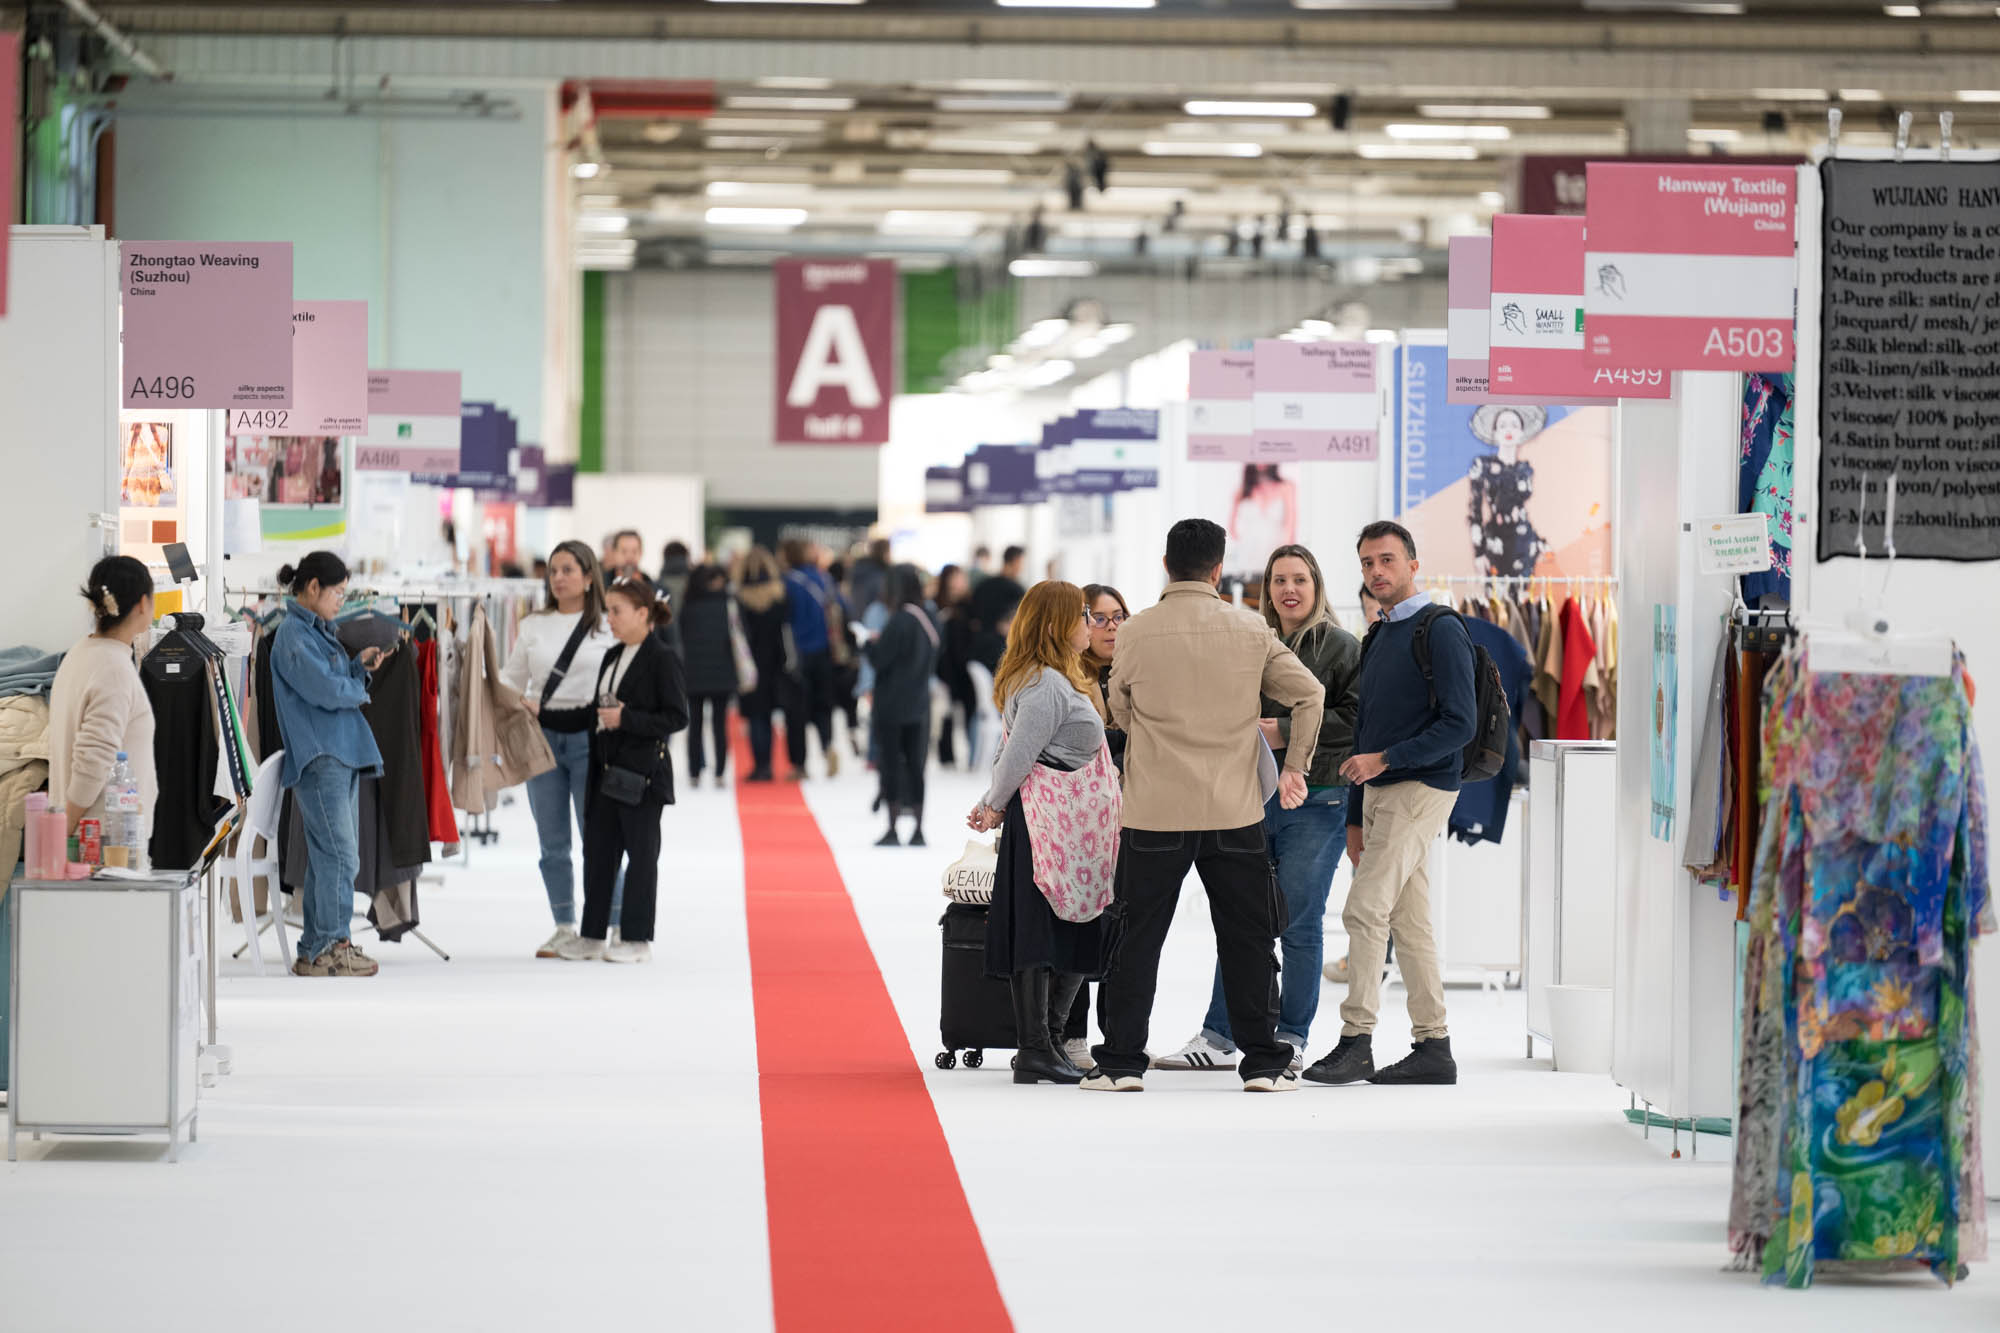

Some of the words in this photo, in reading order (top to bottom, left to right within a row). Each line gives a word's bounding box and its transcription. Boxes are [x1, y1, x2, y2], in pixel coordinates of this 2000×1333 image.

[1658, 176, 1727, 195] Hanway
[1732, 178, 1786, 195] Textile
[1872, 185, 1948, 207] WUJIANG
[1704, 197, 1786, 218] (Wujiang)
[1754, 219, 1786, 231] China
[1831, 217, 1865, 236] Our
[1870, 223, 1948, 239] company
[1953, 220, 1967, 237] is
[1972, 227, 1981, 237] a
[1831, 239, 1889, 262] dyeing
[1893, 243, 1945, 258] textile
[1950, 243, 1995, 260] trade
[130, 254, 195, 269] Zhongtao
[200, 254, 259, 269] Weaving
[130, 270, 190, 284] (Suzhou)
[1831, 265, 1876, 284] Main
[1881, 267, 1957, 287] products
[1962, 273, 1990, 285] are
[130, 287, 156, 296] China
[1929, 292, 1980, 312] satin/
[1535, 308, 1564, 320] SMALL
[1832, 310, 1918, 333] jacquard/
[1924, 315, 1978, 335] mesh/
[1703, 327, 1783, 357] A503
[1830, 336, 1877, 353] 2.Silk
[786, 304, 882, 408] A
[130, 376, 195, 399] A496
[1456, 376, 1472, 384] silky
[237, 410, 288, 429] A492
[1830, 406, 1900, 428] viscose/
[1907, 409, 1948, 425] 100%
[1327, 435, 1371, 453] A491
[1829, 430, 1890, 448] 4.Satin
[1894, 433, 1940, 449] burnt
[1829, 452, 1899, 473] viscose/
[1901, 455, 1950, 474] nylon
